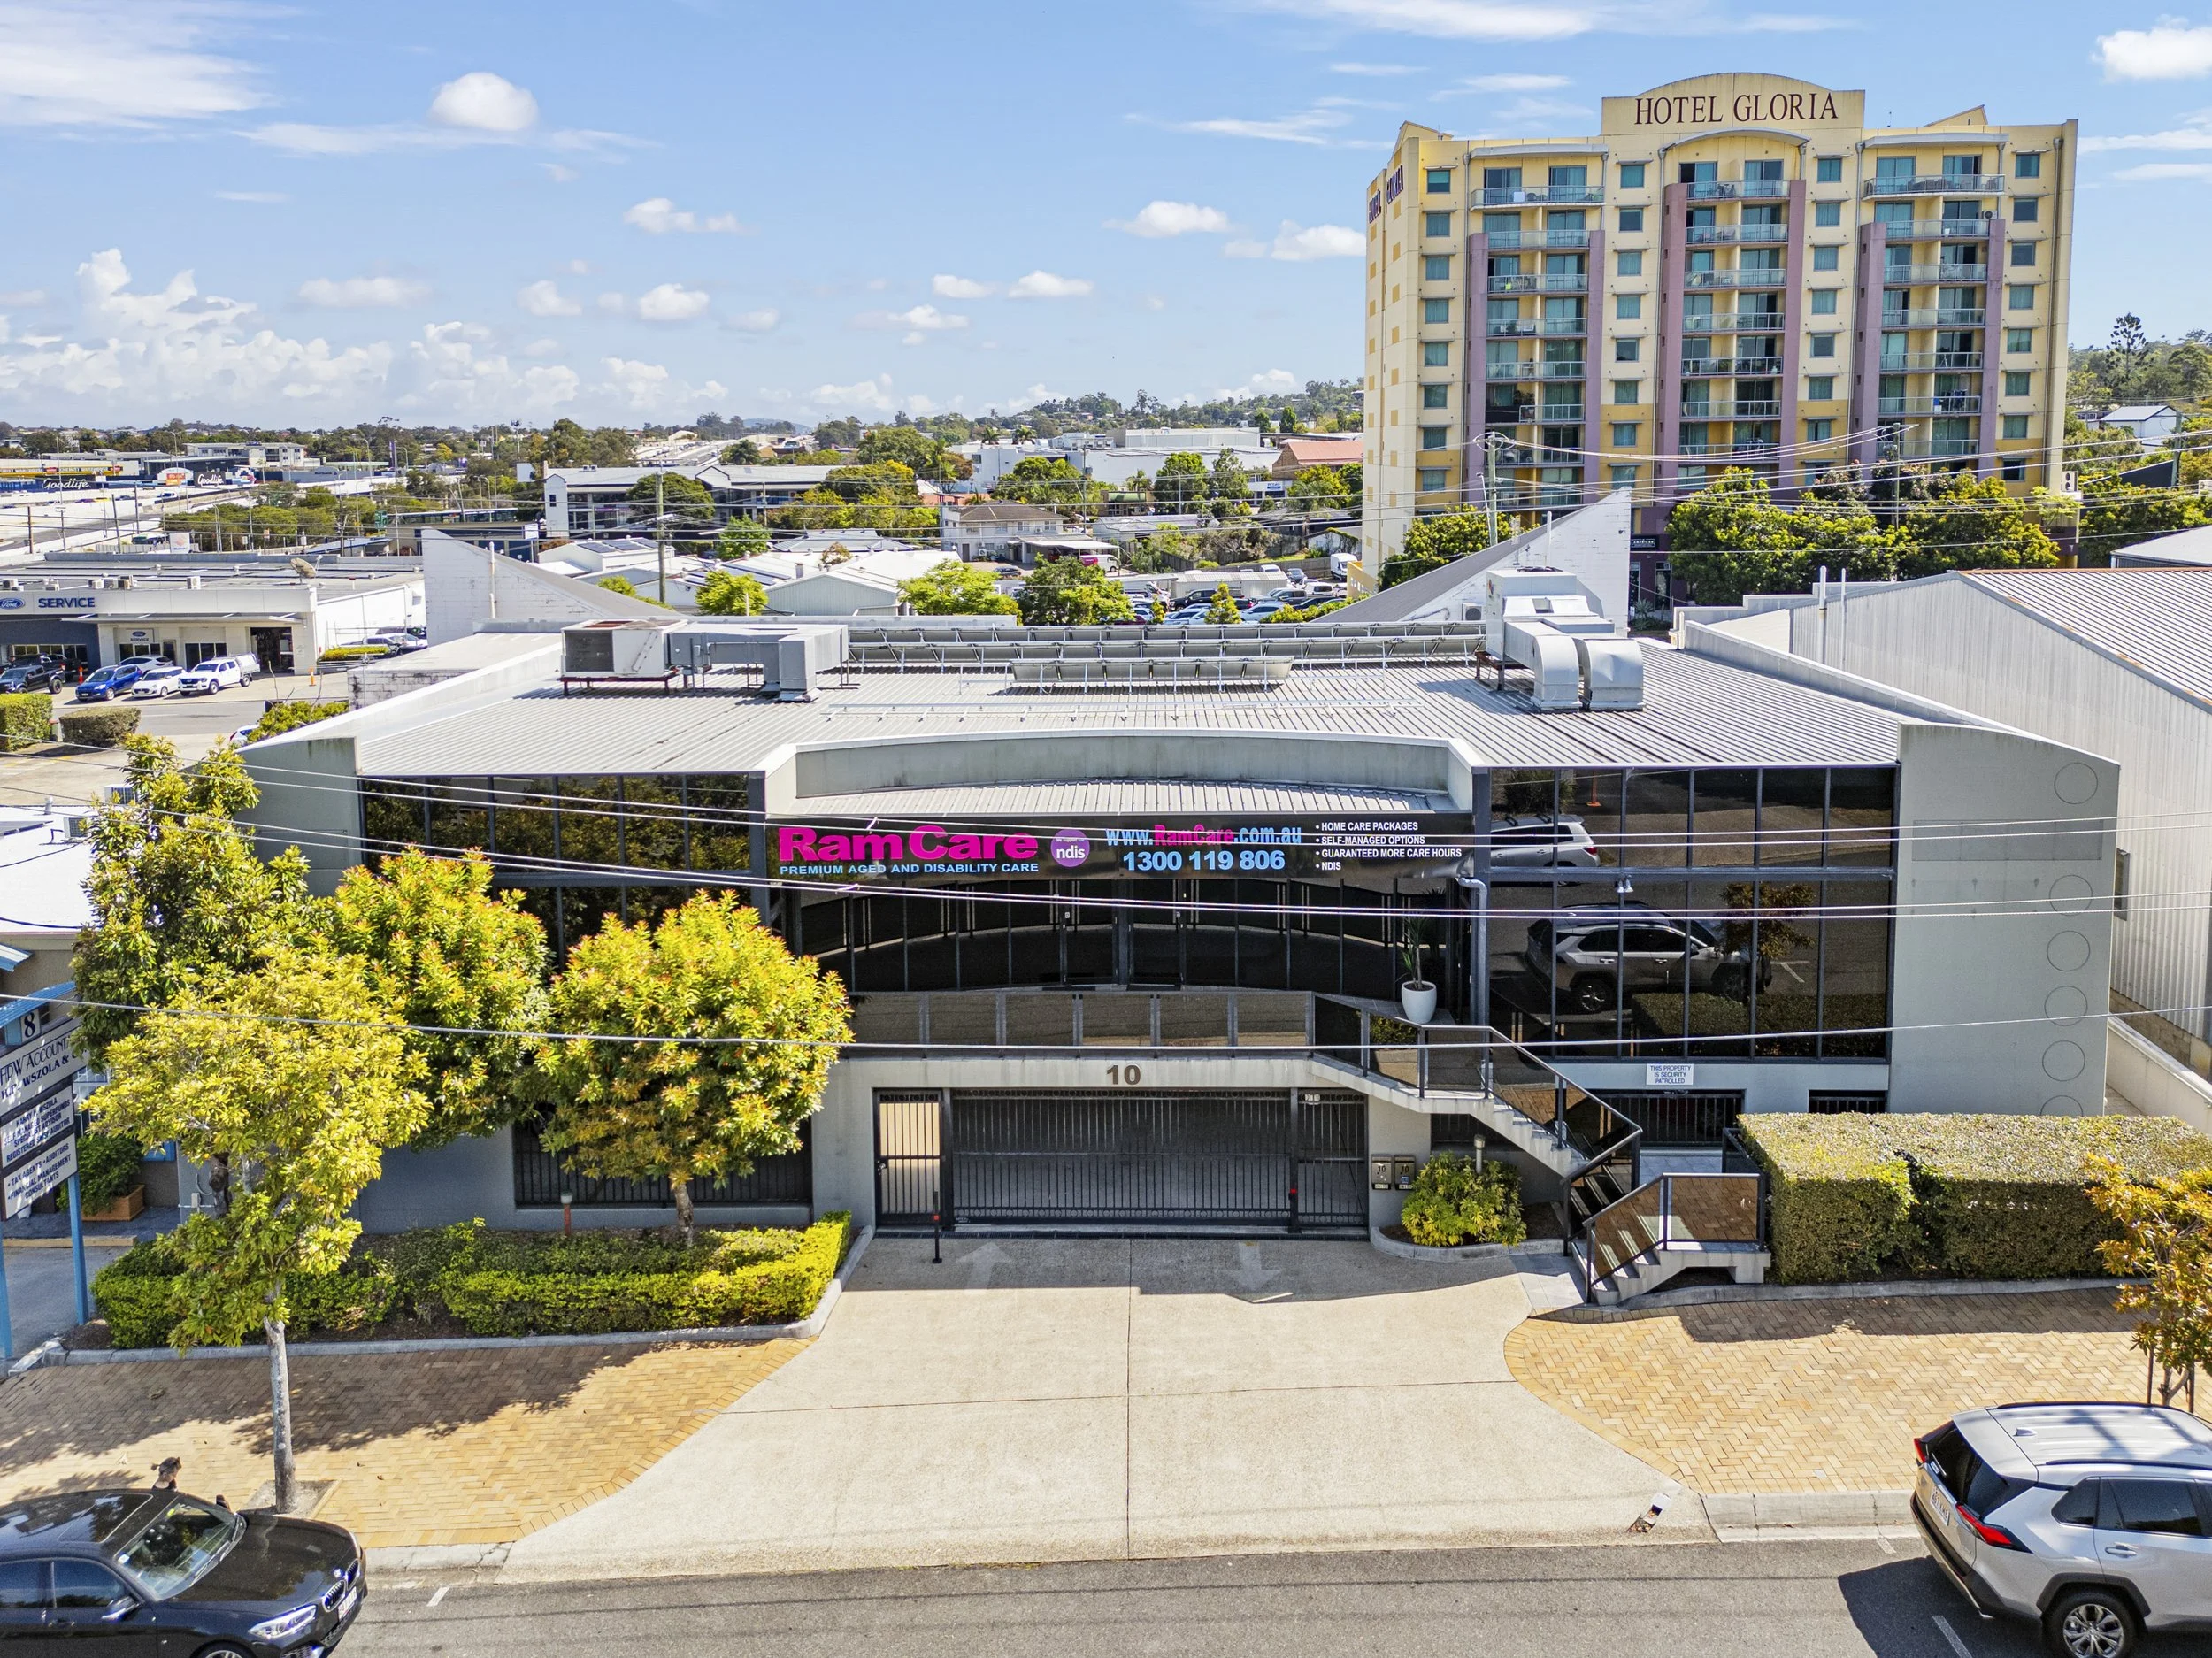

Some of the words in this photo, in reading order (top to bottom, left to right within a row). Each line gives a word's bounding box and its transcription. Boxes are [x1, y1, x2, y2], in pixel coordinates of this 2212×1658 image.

[1634, 96, 1724, 125] HOTEL
[1733, 92, 1839, 122] GLORIA
[42, 478, 89, 490] Goodlife
[197, 473, 225, 487] Goodlife
[38, 597, 95, 608] SERVICE
[1321, 822, 1346, 831] HOME
[1348, 822, 1371, 831] CARE
[1373, 822, 1418, 831] PACKAGES
[1321, 836, 1386, 845] SELF-MANAGED
[1388, 836, 1425, 845] OPTIONS
[1056, 845, 1086, 859] ndis
[1322, 848, 1379, 857] GUARANTEED
[1380, 848, 1405, 857] MORE
[1407, 848, 1431, 857] CARE
[1432, 848, 1462, 857] HOURS
[1123, 851, 1182, 871] 1300
[1189, 850, 1233, 871] 119
[1240, 850, 1286, 871] 806
[1321, 861, 1341, 871] NDIS
[780, 865, 843, 875] PREMIUM
[848, 864, 887, 874] AGED
[891, 864, 919, 873] AND
[924, 863, 998, 873] DISABILITY
[1001, 863, 1039, 872] CARE
[24, 1011, 35, 1038] 8
[26, 1037, 68, 1071] ACCOUNT
[22, 1059, 60, 1086] WSZOLA
[62, 1055, 69, 1065] &
[1107, 1064, 1141, 1085] 10
[22, 1161, 42, 1178] AGENTS
[46, 1143, 69, 1163] AUDITORS
[37, 1154, 71, 1181] MANAGEMENT
